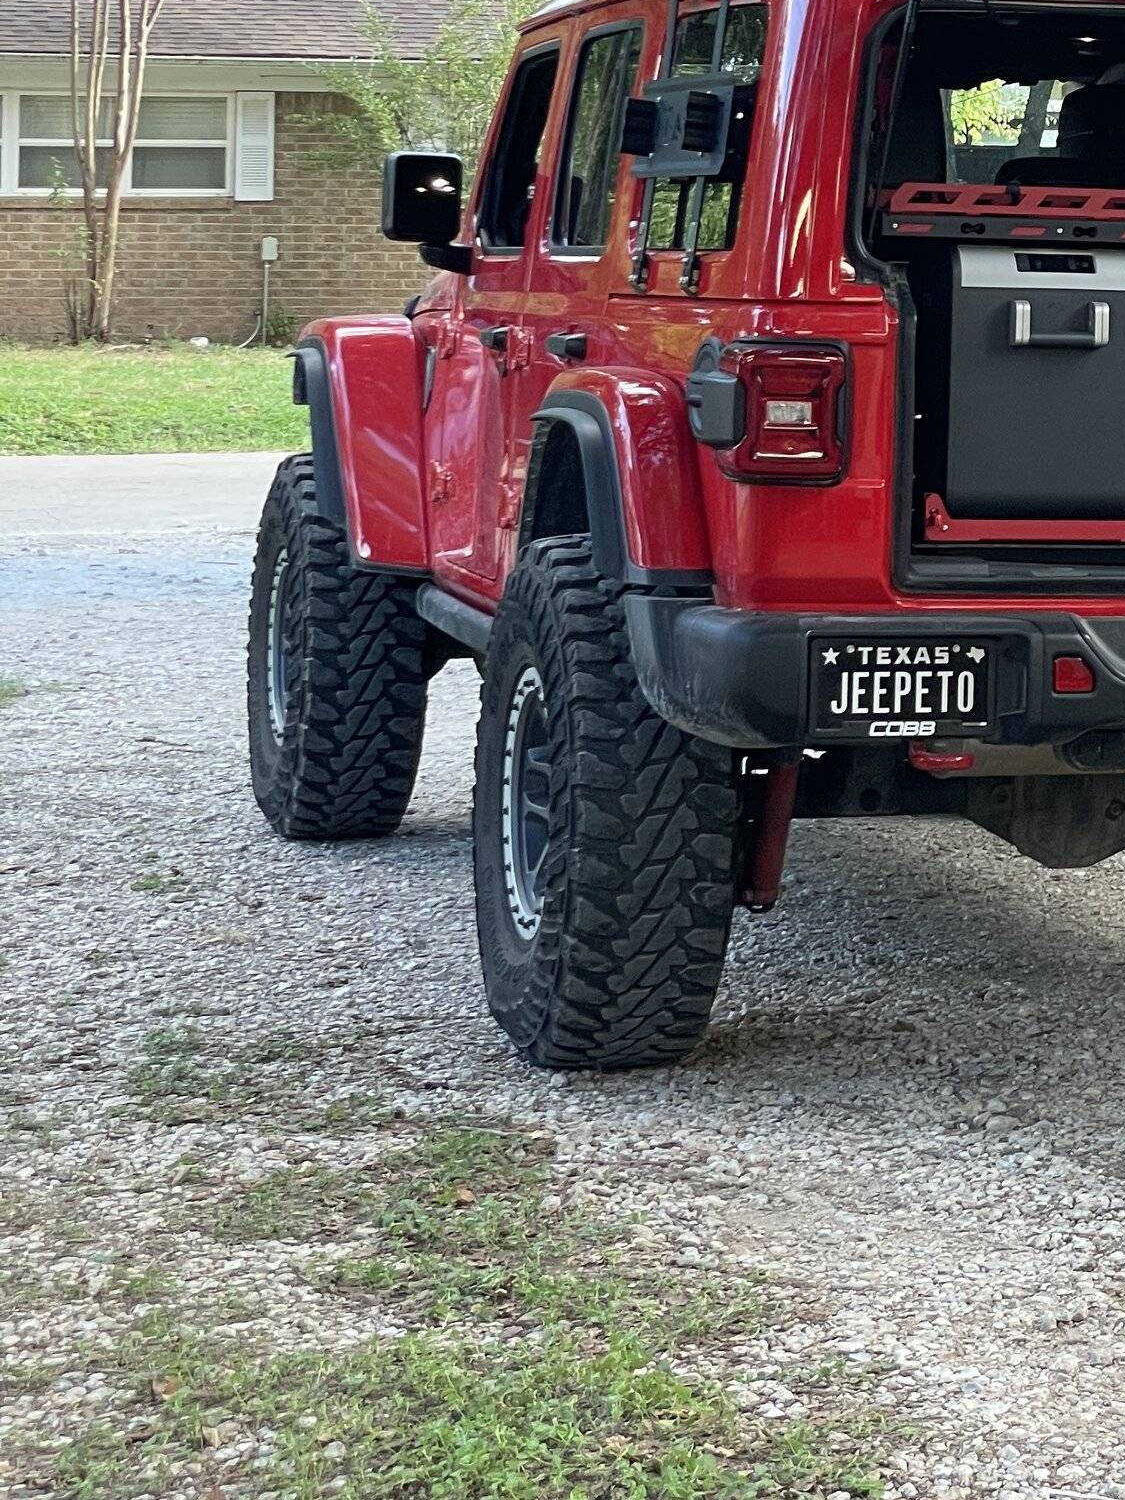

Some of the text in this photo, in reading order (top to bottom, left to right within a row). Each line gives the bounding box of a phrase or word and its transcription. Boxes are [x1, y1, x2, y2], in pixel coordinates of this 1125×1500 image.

[857, 646, 950, 665] TEXAS
[830, 670, 975, 714] JEEPETO
[868, 720, 936, 737] COBB
